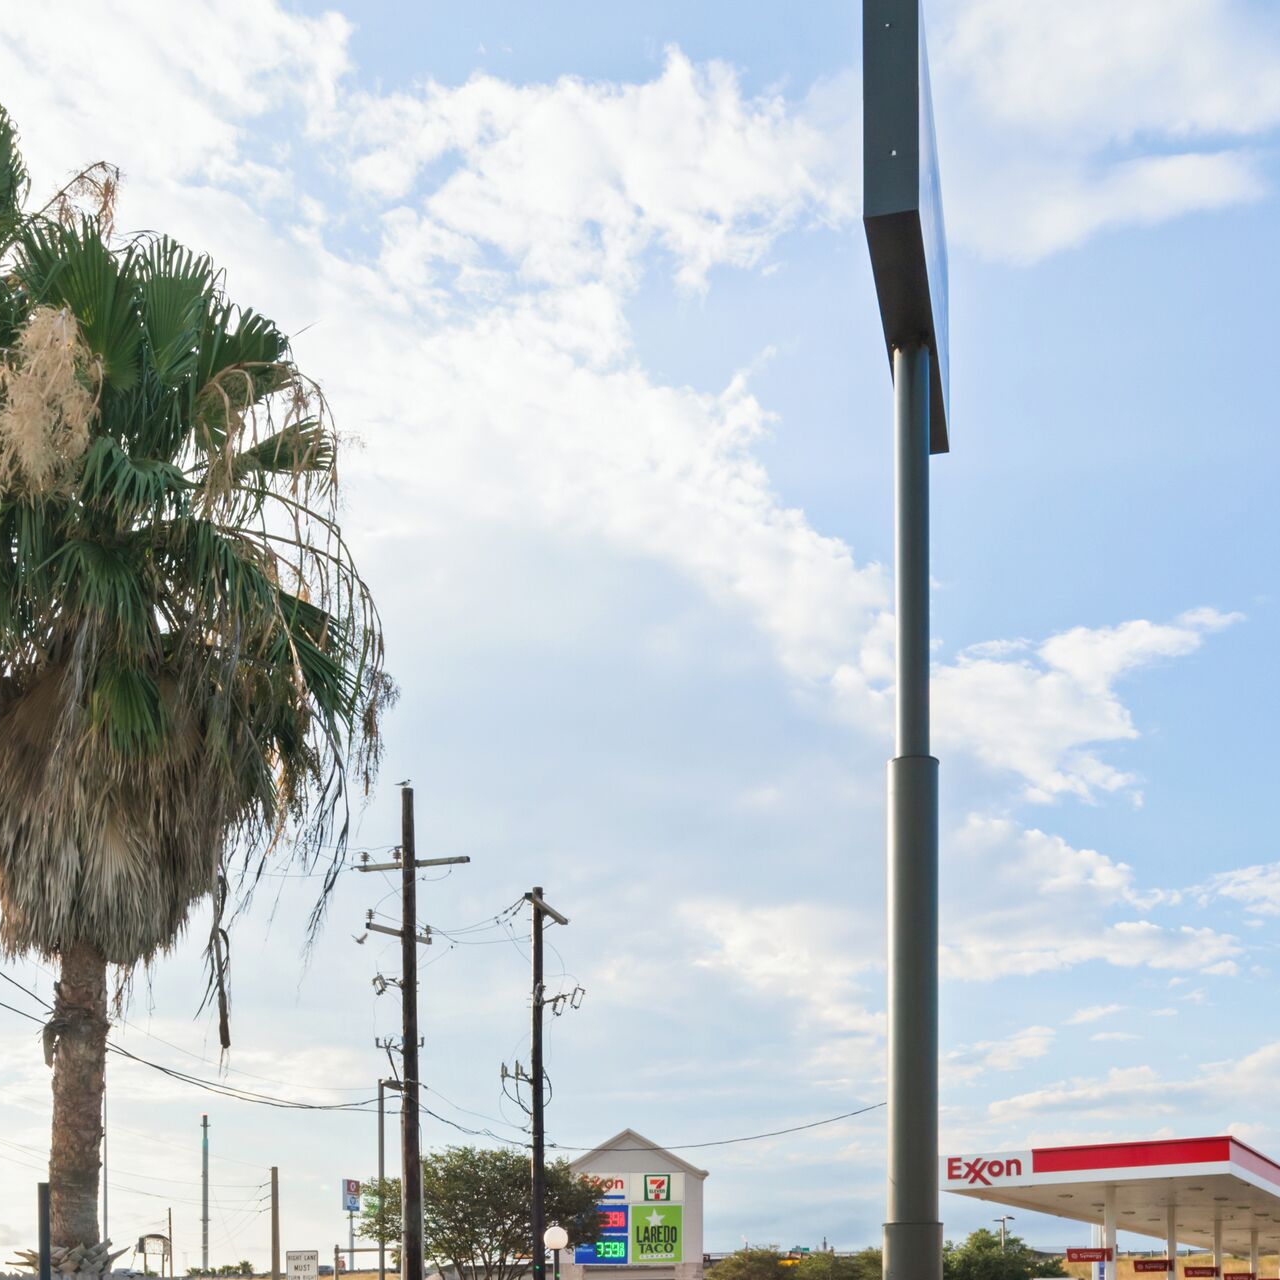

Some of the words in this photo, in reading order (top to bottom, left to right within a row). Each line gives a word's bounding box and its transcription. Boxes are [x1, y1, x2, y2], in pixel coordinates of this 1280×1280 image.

[947, 1157, 1022, 1186] Exxon
[636, 1225, 677, 1243] LAREDO
[639, 1243, 674, 1254] TACO
